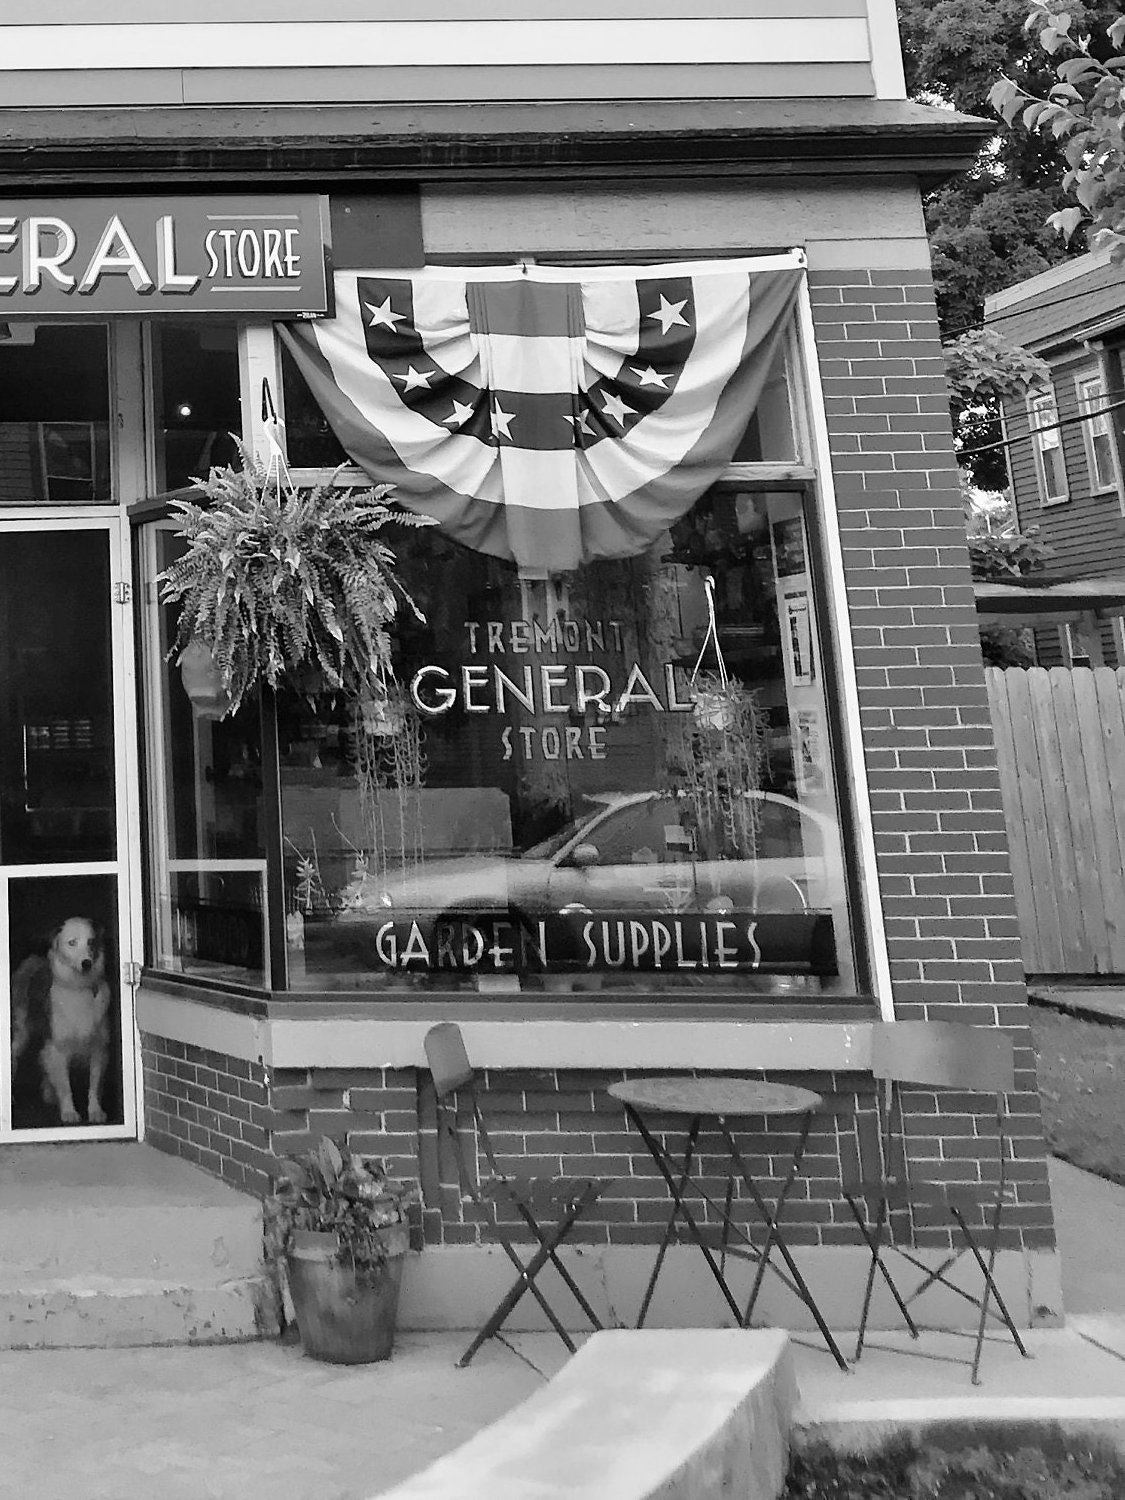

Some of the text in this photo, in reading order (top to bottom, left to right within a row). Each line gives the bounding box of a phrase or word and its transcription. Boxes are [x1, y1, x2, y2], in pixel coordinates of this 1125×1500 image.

[205, 228, 301, 279] STORE
[463, 619, 627, 655] TREMONT
[410, 663, 698, 714] GENERAL
[501, 725, 608, 761] STORE
[375, 920, 763, 970] GARDEN SUPPLIES
